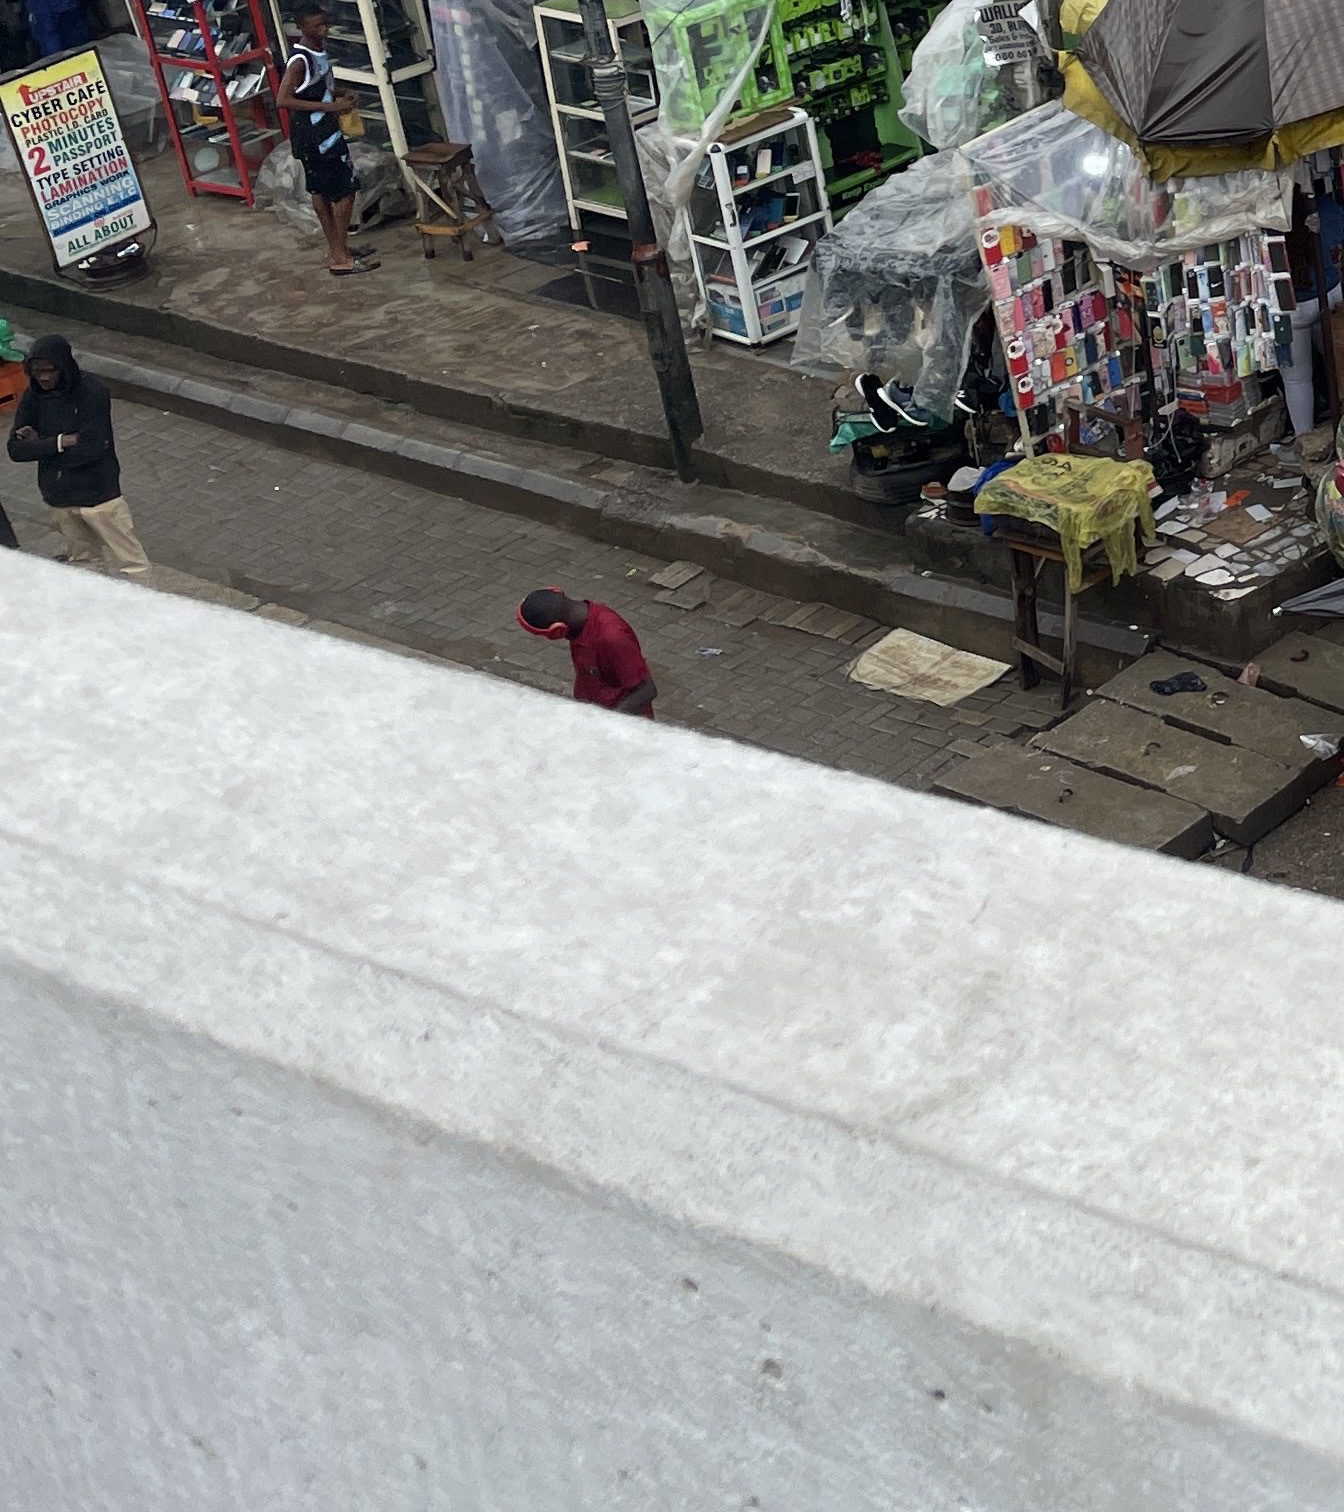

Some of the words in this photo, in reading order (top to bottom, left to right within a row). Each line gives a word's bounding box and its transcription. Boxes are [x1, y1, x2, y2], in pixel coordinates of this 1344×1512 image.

[28, 76, 84, 104] UPSTAIR
[11, 97, 63, 128] CYBER
[20, 96, 105, 140] PHOTOCOPY
[25, 125, 65, 149] PLASTIC
[84, 107, 109, 125] CARD
[48, 116, 116, 155] MINUTES
[52, 130, 118, 168] PASSPORT
[28, 145, 52, 177] 2
[36, 163, 73, 190] TYPE
[74, 144, 125, 177] SETTING
[40, 156, 129, 204] LAMINATION
[44, 181, 99, 211] GRAPHICS
[99, 169, 130, 188] WORK
[46, 175, 135, 221] SCANNING
[50, 201, 106, 230] BINDING
[67, 234, 91, 253] ALL
[93, 214, 136, 242] ABOUT
